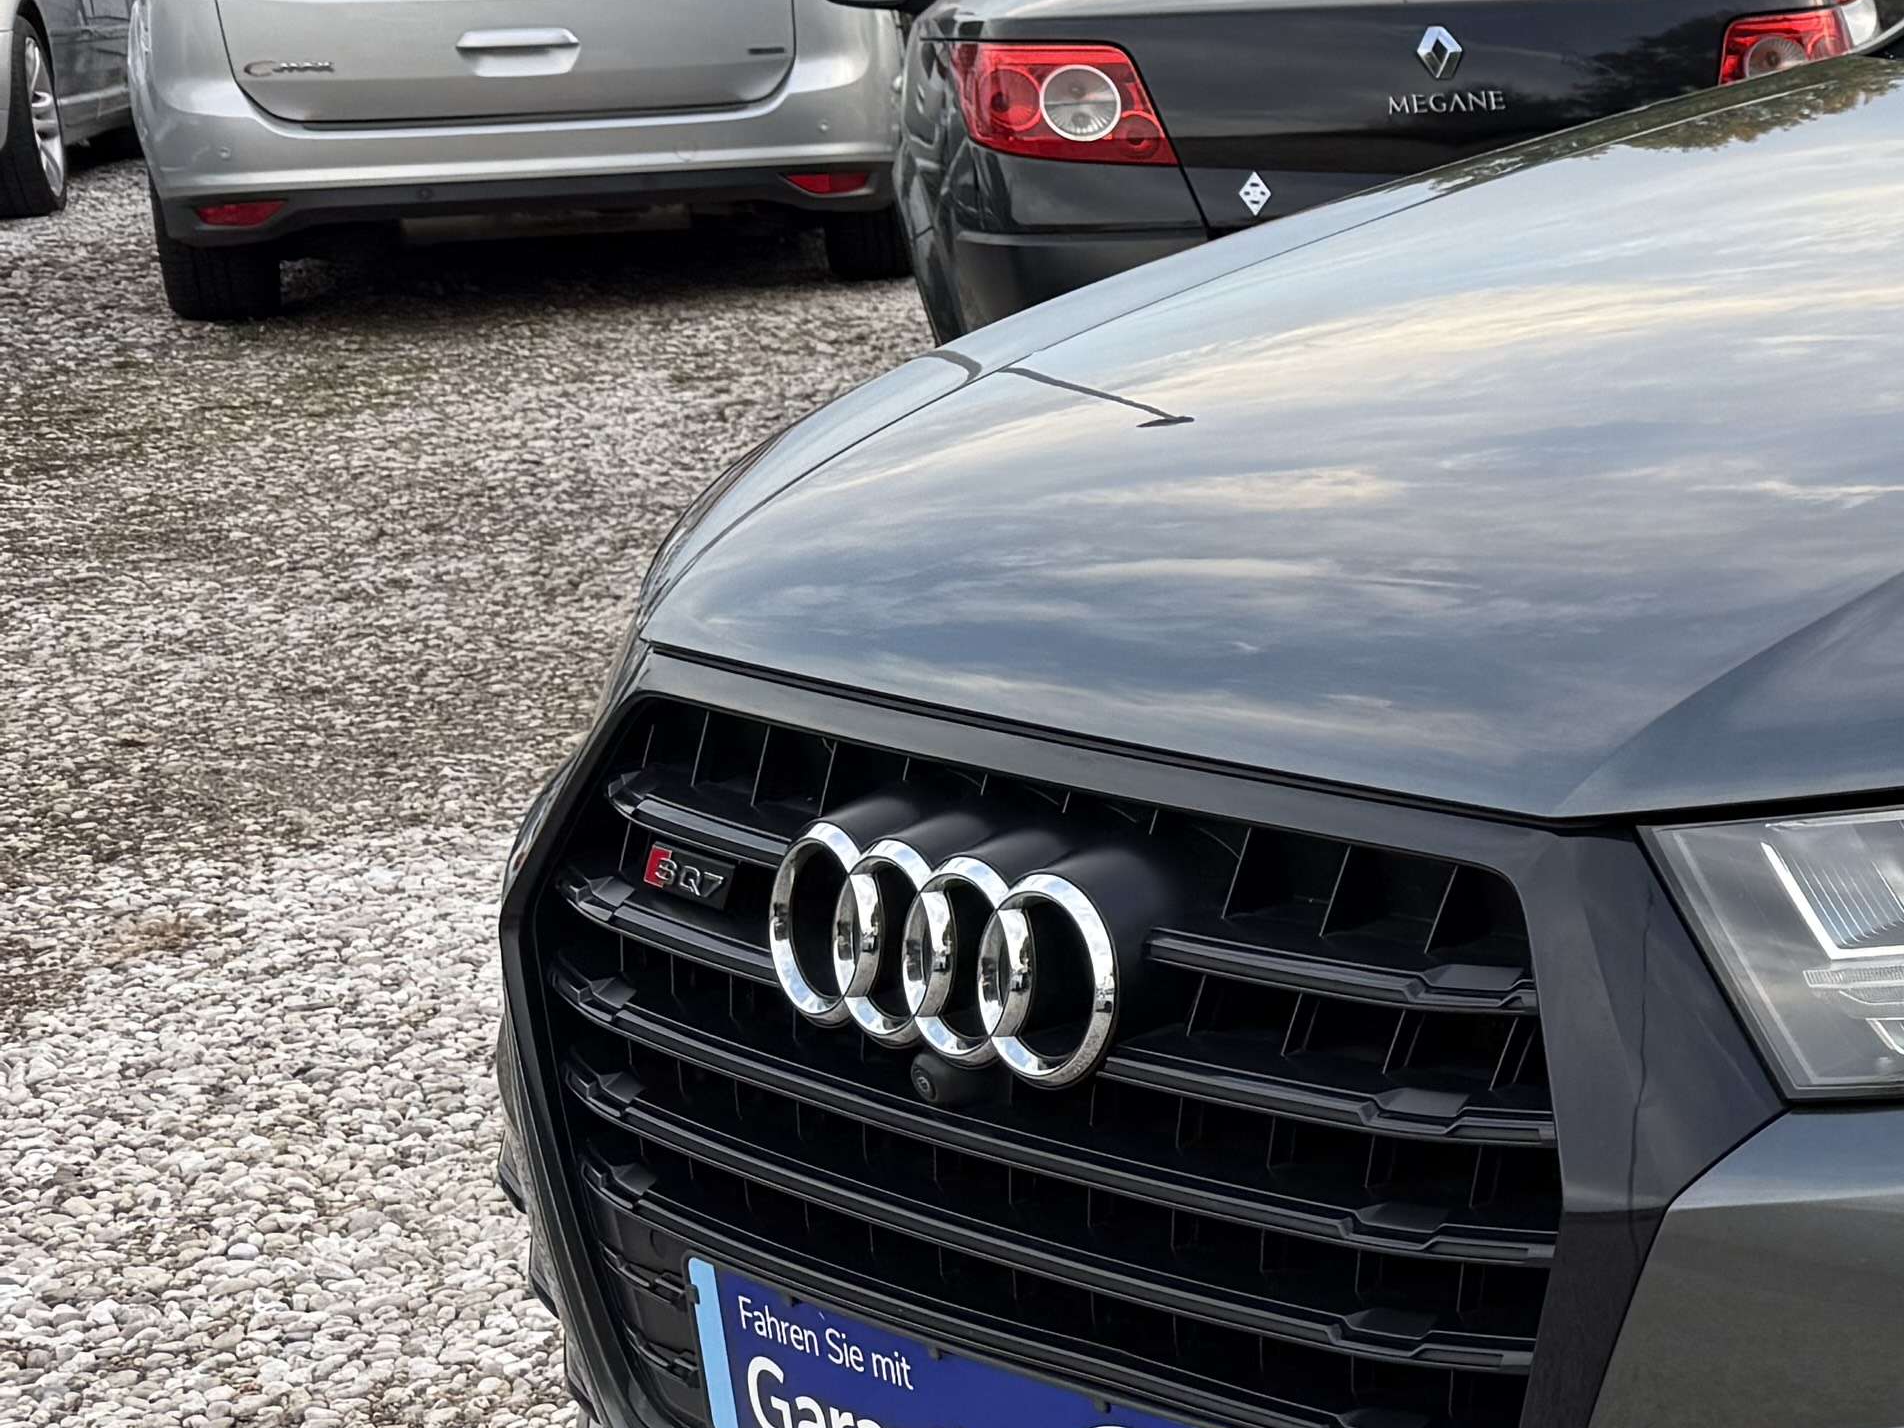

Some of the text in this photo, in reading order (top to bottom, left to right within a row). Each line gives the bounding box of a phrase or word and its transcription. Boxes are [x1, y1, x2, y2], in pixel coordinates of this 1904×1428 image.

[1388, 90, 1506, 115] MEGANE
[655, 857, 724, 898] SQ7
[737, 1295, 914, 1390] Fahren Sie mit
